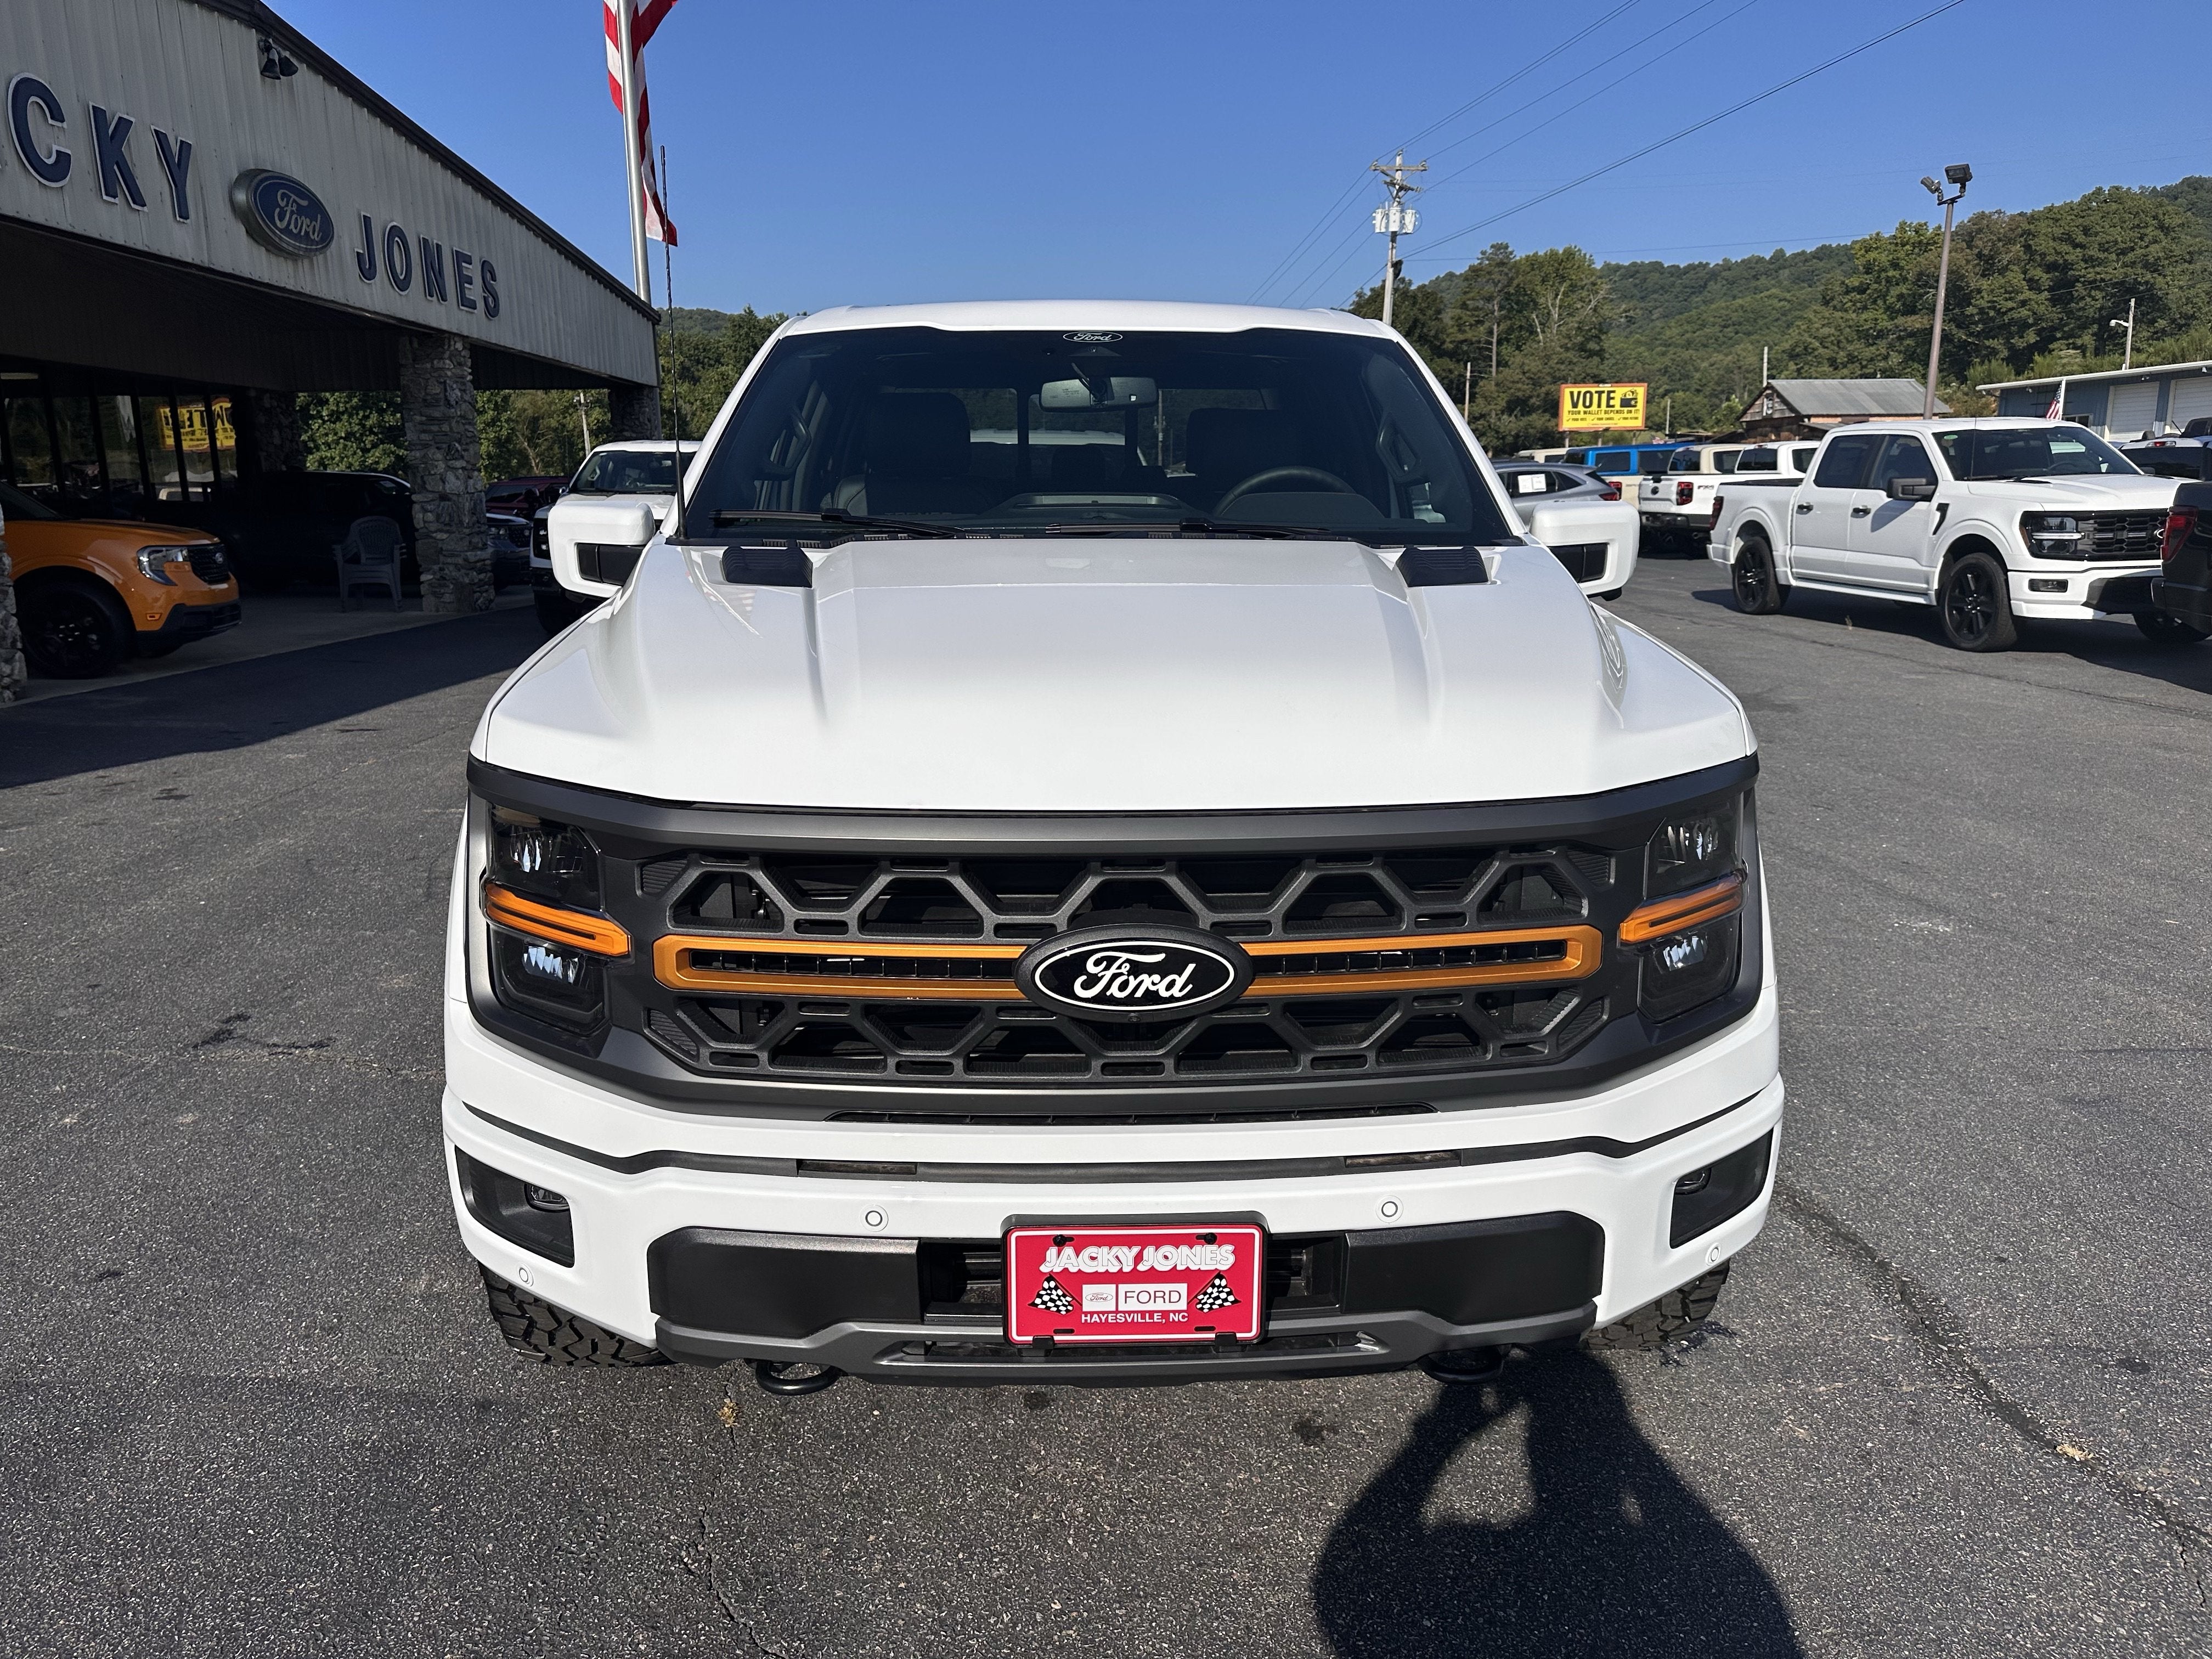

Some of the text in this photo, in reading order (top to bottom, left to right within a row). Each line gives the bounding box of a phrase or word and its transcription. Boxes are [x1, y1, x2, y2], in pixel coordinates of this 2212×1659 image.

[0, 72, 500, 320] CKY JONES
[274, 189, 323, 241] Ford
[1073, 332, 1113, 341] Ford
[1569, 390, 1616, 409] VOTE
[1074, 951, 1197, 998] Ford
[1039, 1245, 1235, 1273] JACKY JONES
[1090, 1290, 1181, 1304] Ford FORD
[1081, 1312, 1188, 1324] HAYESVILLE, NC
